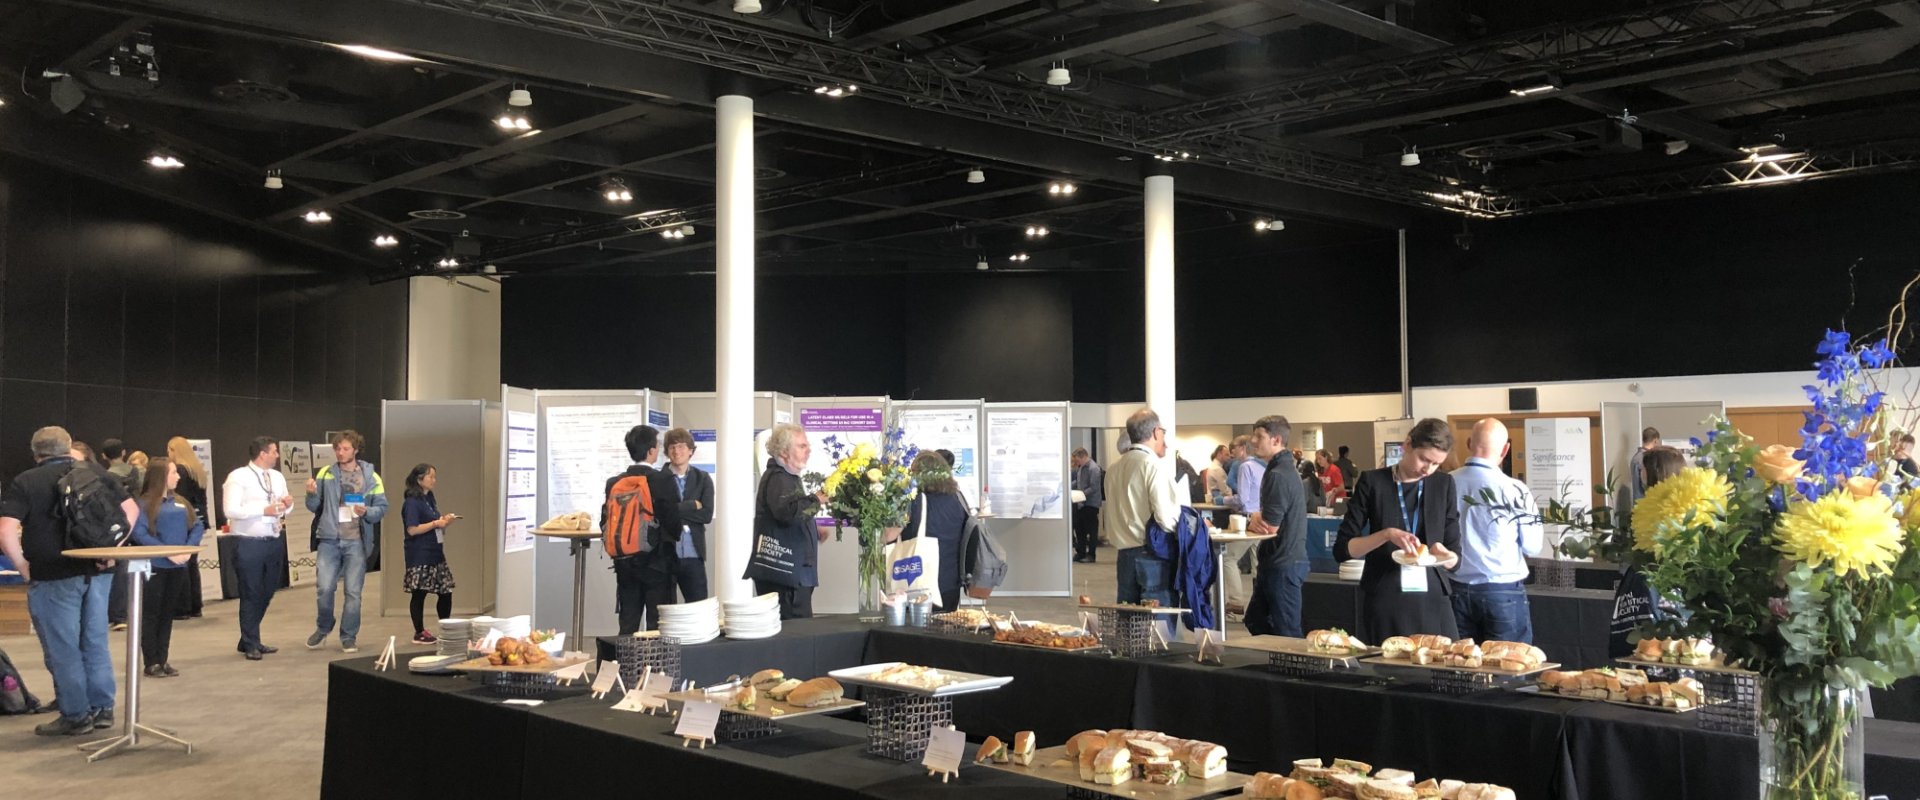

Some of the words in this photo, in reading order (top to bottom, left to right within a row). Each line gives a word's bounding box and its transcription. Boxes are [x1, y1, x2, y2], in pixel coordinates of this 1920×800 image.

[1532, 453, 1576, 464] Significance
[763, 536, 780, 546] ROYAL
[761, 541, 793, 555] STATISTICAL
[761, 547, 783, 558] SOCIETY
[899, 561, 921, 572] SAGE
